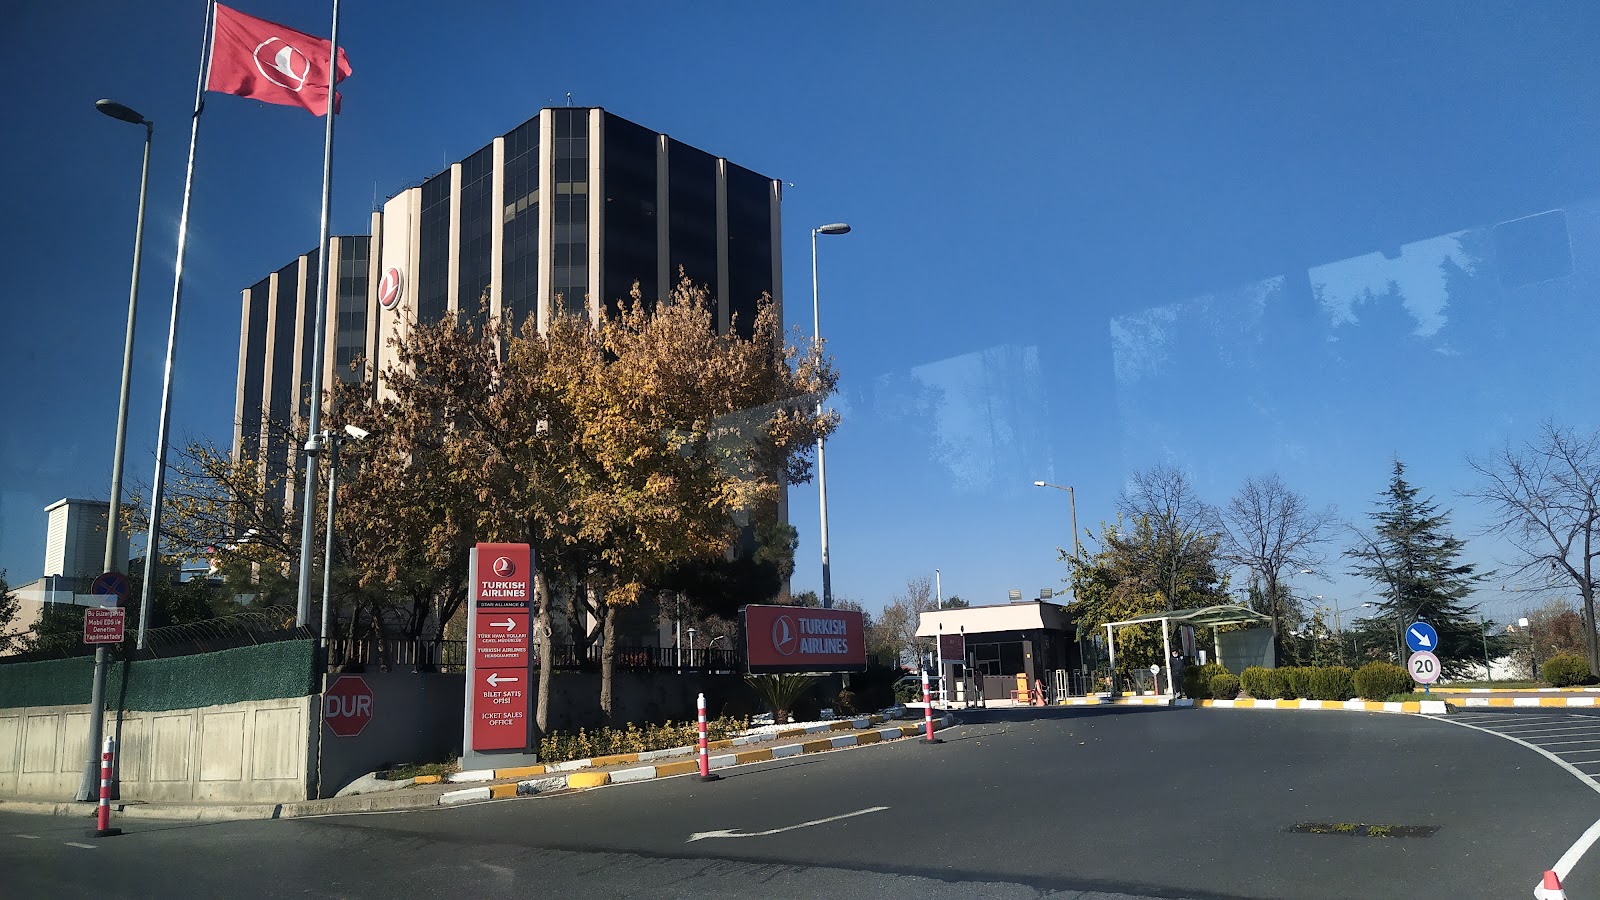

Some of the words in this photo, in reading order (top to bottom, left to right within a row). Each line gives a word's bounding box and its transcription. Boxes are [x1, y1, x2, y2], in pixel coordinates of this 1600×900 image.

[798, 618, 846, 635] TURKISH
[800, 638, 848, 654] AIRLINES
[1415, 660, 1434, 673] 20
[326, 695, 371, 717] DUR
